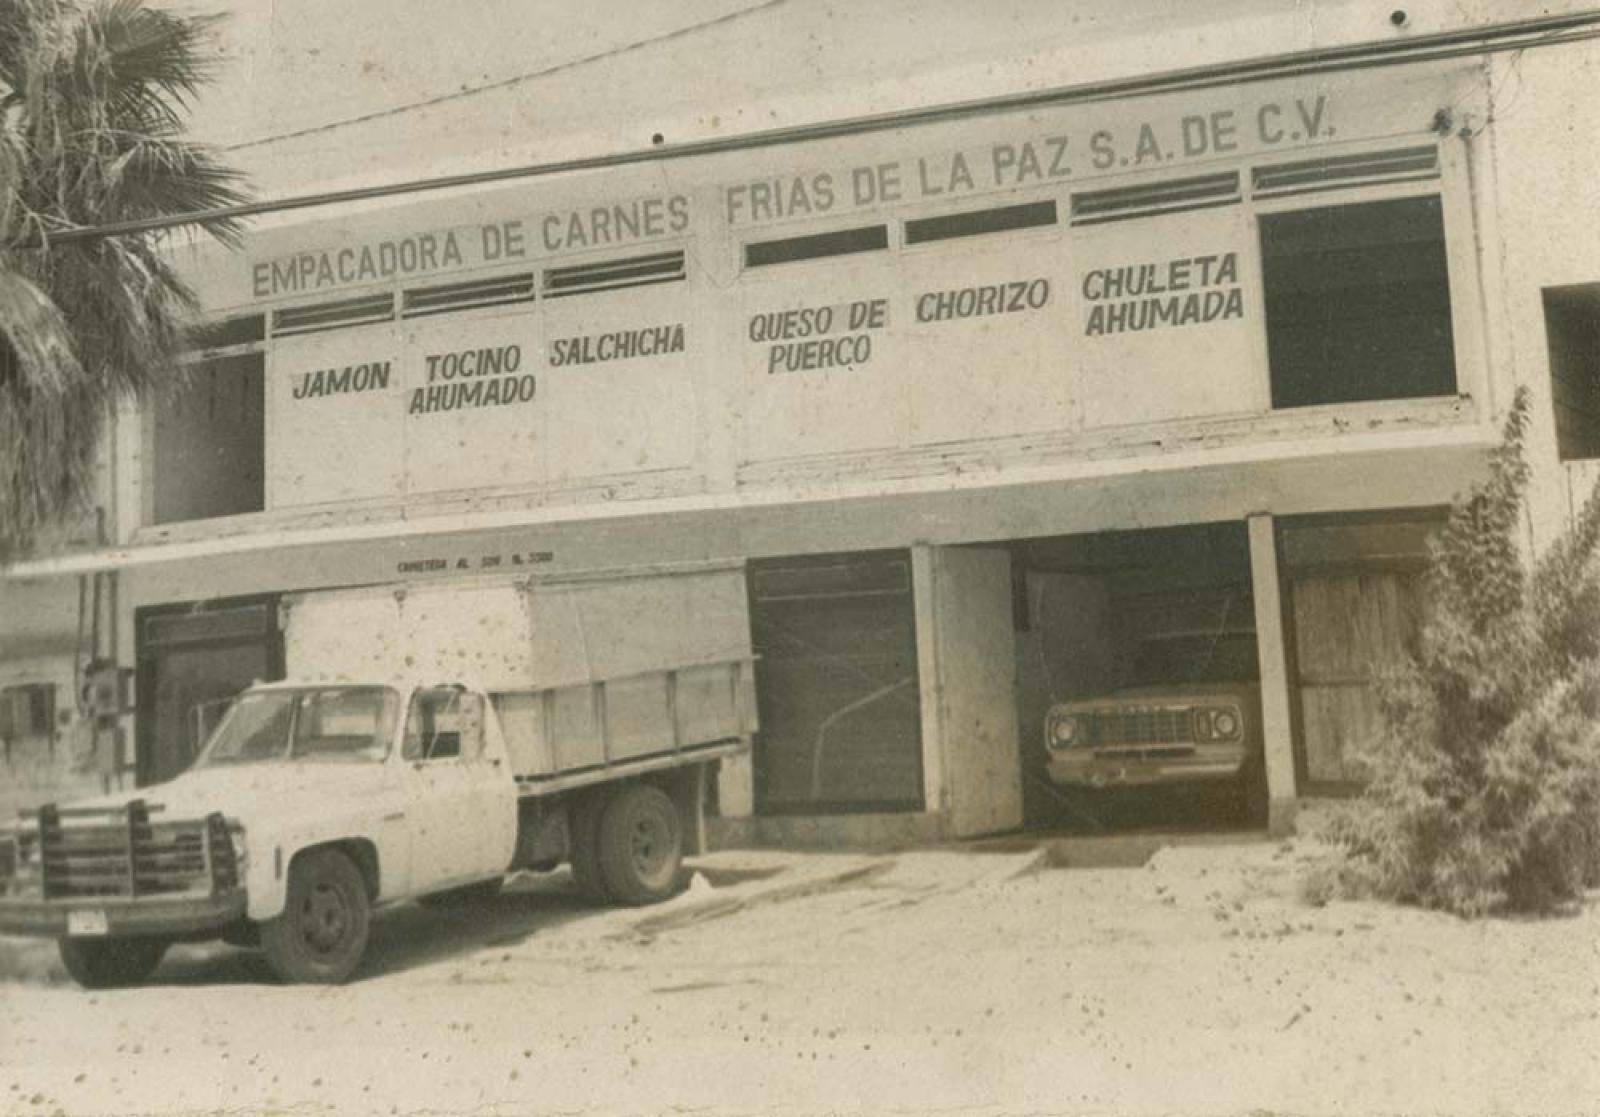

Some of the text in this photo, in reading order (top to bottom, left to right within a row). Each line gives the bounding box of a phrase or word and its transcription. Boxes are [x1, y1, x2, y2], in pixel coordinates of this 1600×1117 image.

[253, 231, 462, 297] EMPACADORA
[482, 220, 525, 261] DE
[542, 194, 689, 250] CARNES
[726, 173, 835, 224] FRIAS
[852, 161, 901, 205] DE
[918, 151, 974, 197] LA
[992, 136, 1072, 185] PAZ
[1081, 252, 1239, 301] CHULETA
[749, 299, 887, 343] QUESO DE
[915, 278, 1050, 324] CHORIZO
[1085, 287, 1245, 337] AHUMADA
[425, 344, 521, 382] TOCINO
[549, 323, 686, 367] SALCHICHA
[768, 335, 872, 374] PUERCO
[293, 361, 391, 400] JAMON
[409, 374, 536, 414] AHUMADO
